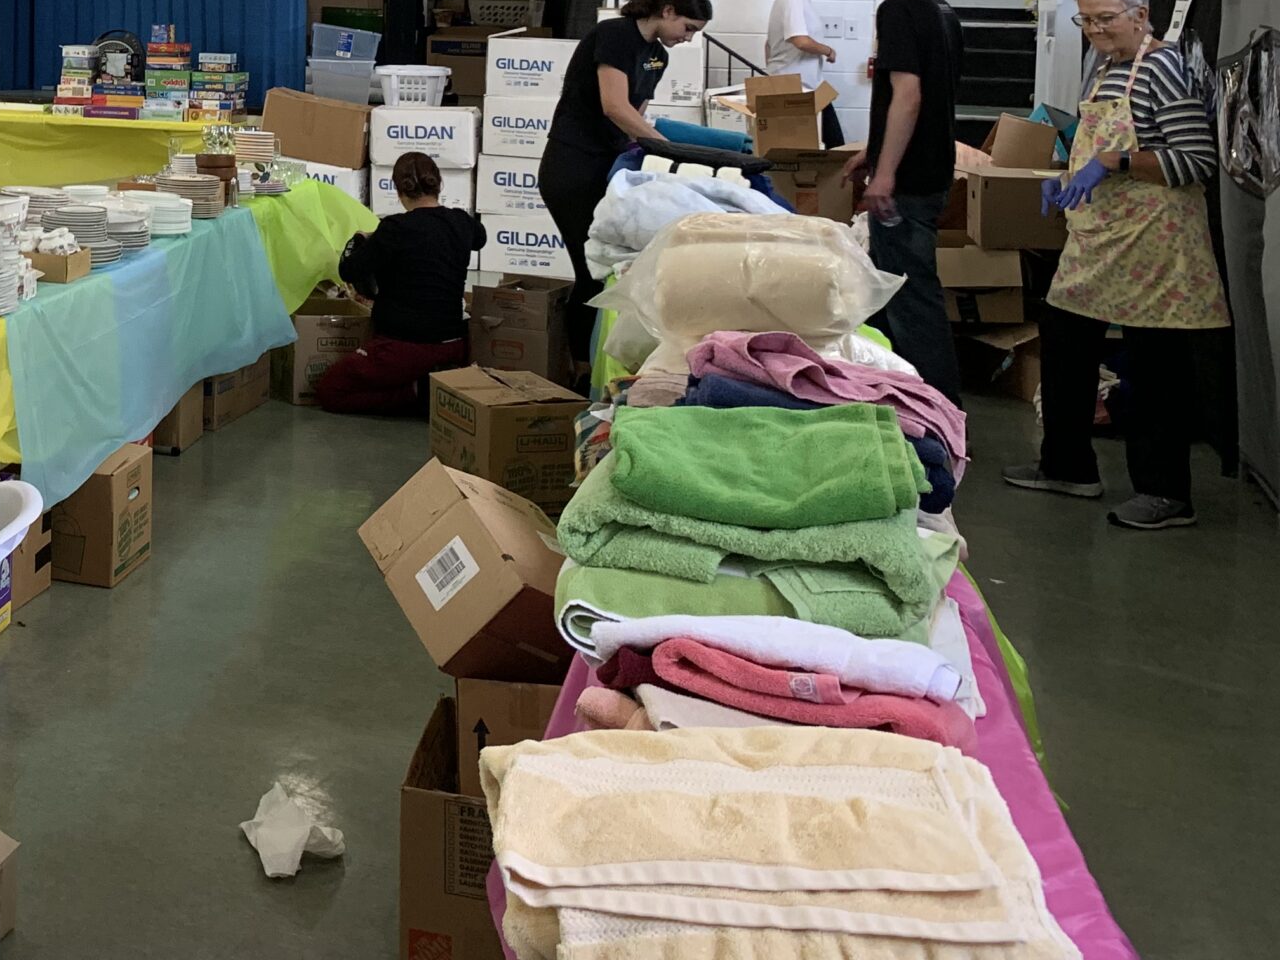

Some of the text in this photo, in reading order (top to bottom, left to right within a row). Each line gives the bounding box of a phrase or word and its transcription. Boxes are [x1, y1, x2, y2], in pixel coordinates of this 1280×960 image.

[496, 58, 552, 72] GILDAN
[492, 116, 547, 130] GILDAN
[387, 125, 453, 139] GILDAN
[493, 171, 540, 189] GILD
[497, 230, 564, 248] GILDAN
[438, 391, 473, 423] U-HAUL
